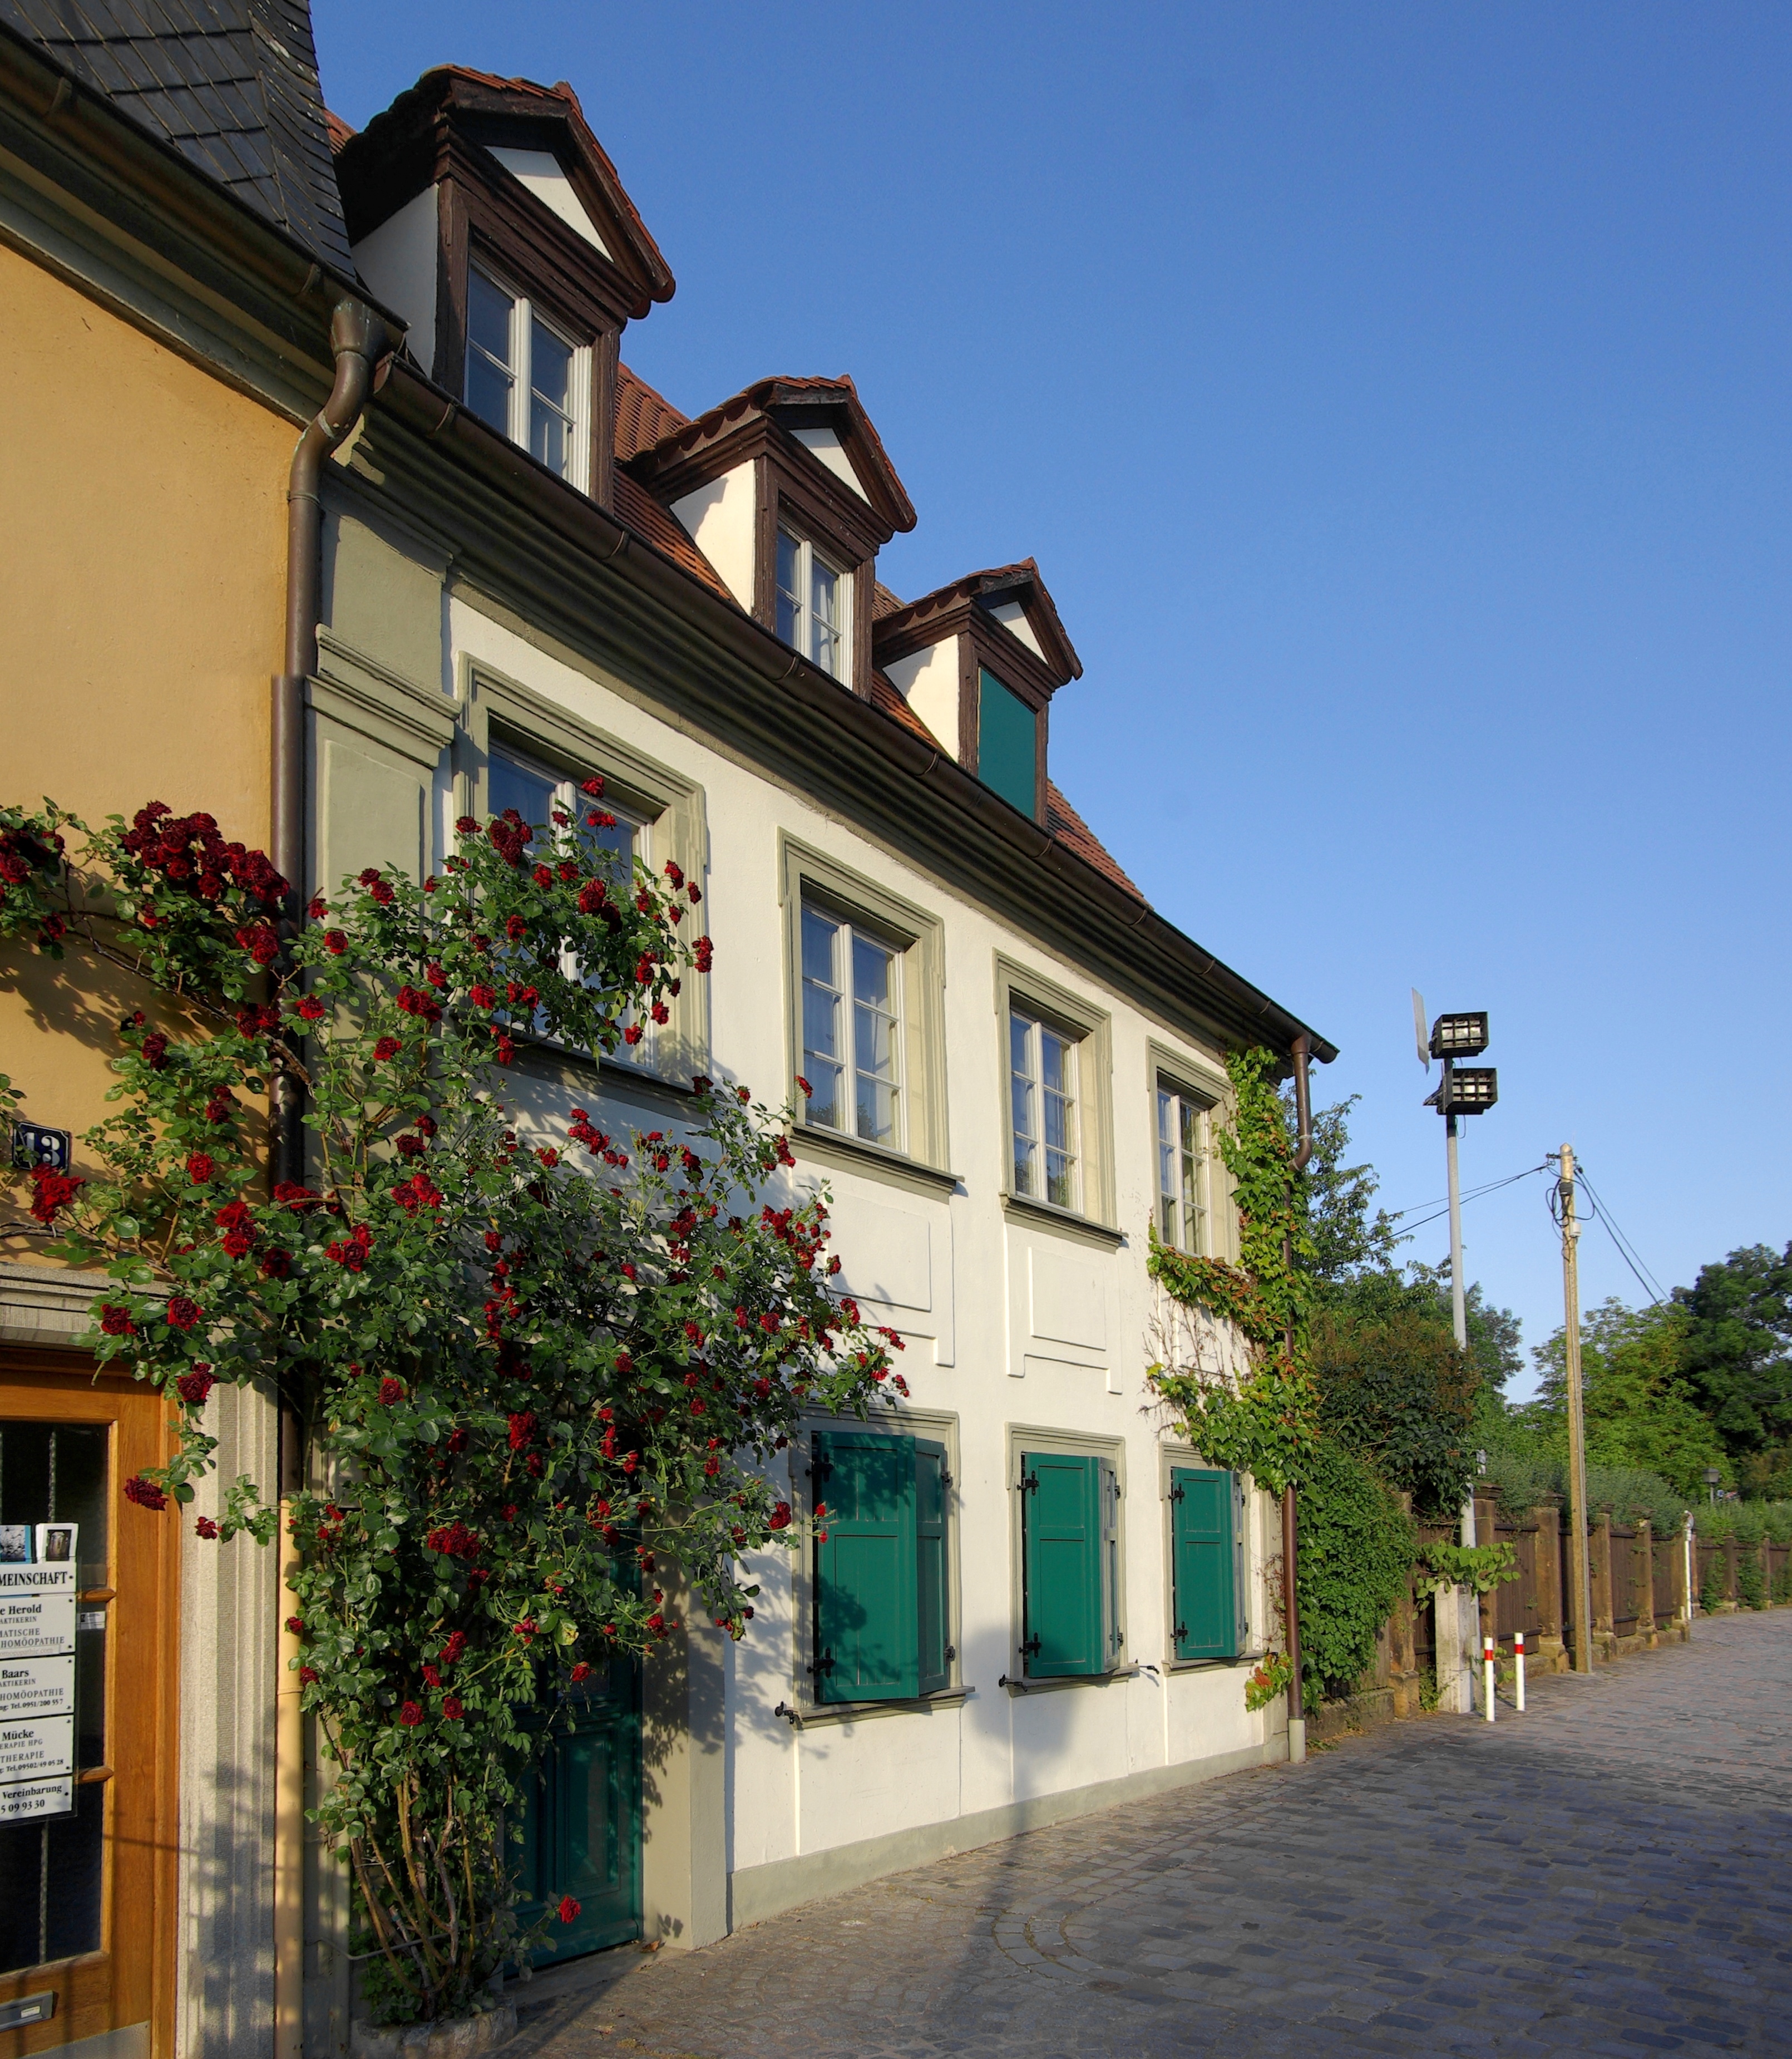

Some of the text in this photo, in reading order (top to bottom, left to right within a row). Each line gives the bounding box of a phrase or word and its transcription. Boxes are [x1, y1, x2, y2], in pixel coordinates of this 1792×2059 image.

[23, 1132, 60, 1166] 13
[8, 1604, 42, 1615] Herold
[1, 1637, 65, 1648] HOMÖOPATHIE
[2, 1670, 29, 1679] Baars
[0, 1688, 64, 1700] HOMÖOPATHIE
[2, 1729, 34, 1741] Mücke
[0, 1741, 26, 1750] ERAPIE
[1, 1751, 45, 1763] THERAPIE
[3, 1785, 62, 1799] Vereinbarung
[1, 1799, 45, 1814] 5 09 93 30
